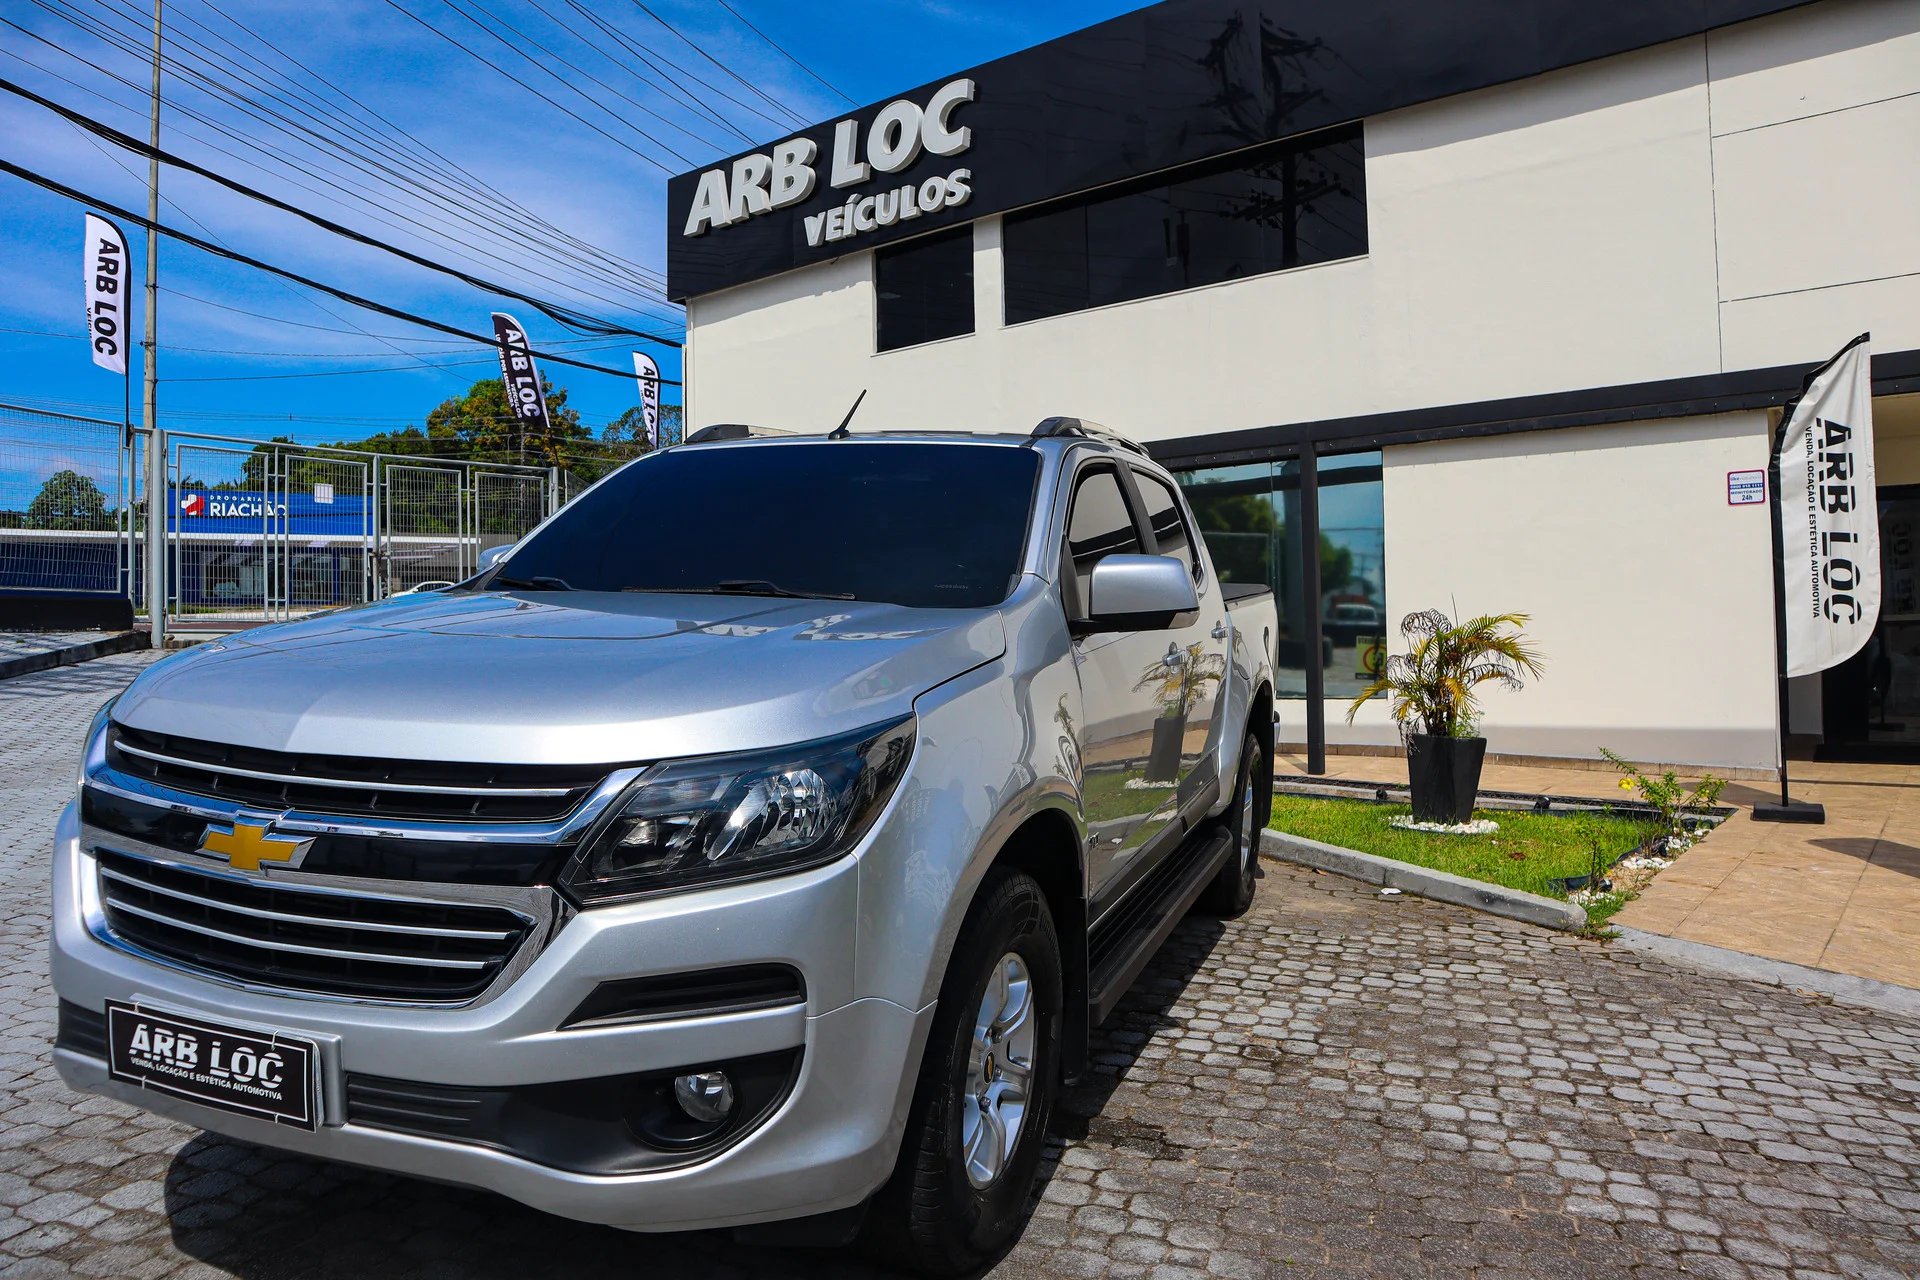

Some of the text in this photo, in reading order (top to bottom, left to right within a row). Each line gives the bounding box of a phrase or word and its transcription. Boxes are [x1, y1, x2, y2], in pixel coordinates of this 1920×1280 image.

[683, 78, 975, 238] ARB LOC
[804, 168, 972, 247] VEÍCULOS
[94, 238, 120, 356] ARB LOC
[515, 376, 541, 417] LOC
[1804, 426, 1814, 459] VENDA,
[1806, 460, 1816, 503] LOCAÇÃO
[210, 501, 287, 517] RIACHÃO
[1815, 416, 1863, 625] ARB LOC
[1808, 513, 1819, 558] ESTÉTICA
[1811, 559, 1820, 619] AUTOMOTIVA
[128, 1023, 284, 1090] ARB LOC
[155, 1064, 189, 1079] LOCAÇÃO
[189, 1072, 195, 1080] E
[196, 1073, 232, 1089] ESTÉTICA
[232, 1083, 283, 1101] AUTOMOTIVA
